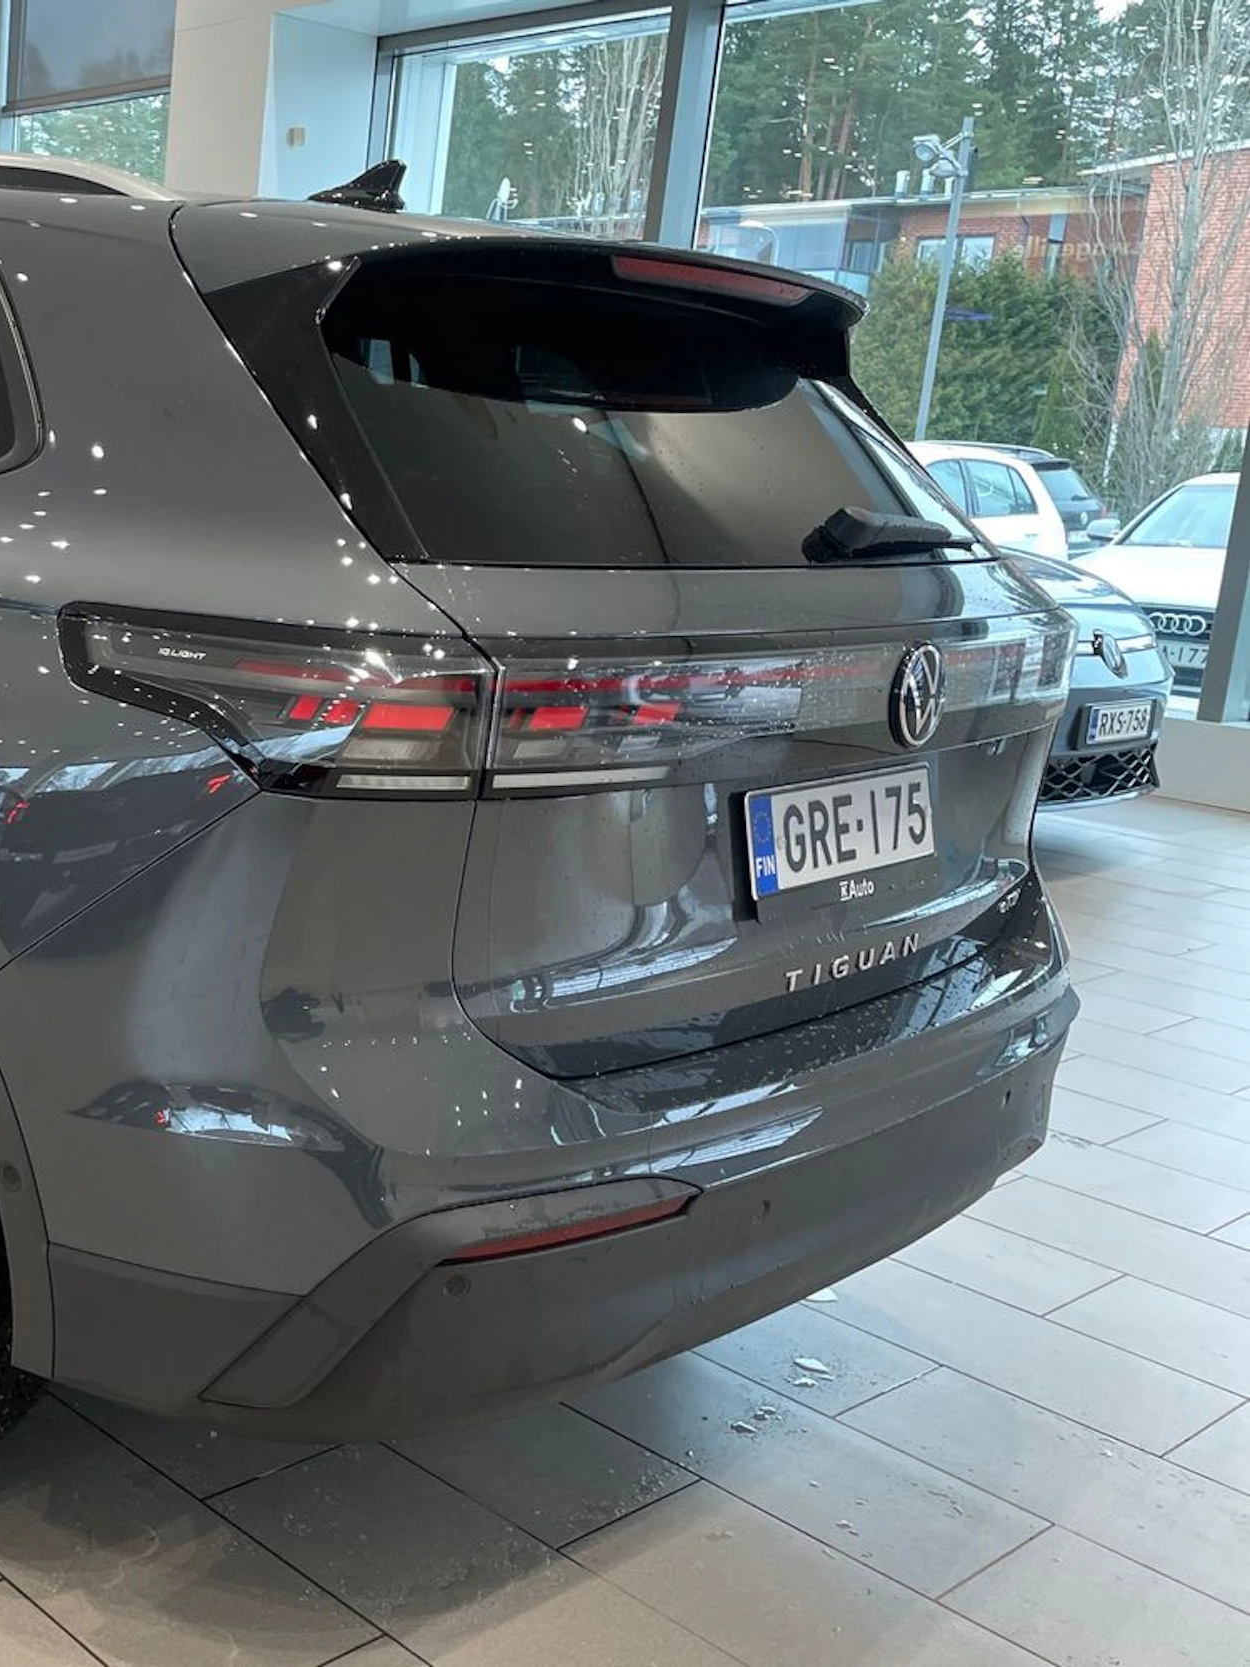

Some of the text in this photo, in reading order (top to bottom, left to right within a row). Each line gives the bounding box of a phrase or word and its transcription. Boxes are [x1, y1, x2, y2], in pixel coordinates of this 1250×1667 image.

[783, 782, 927, 873] GRE-175
[756, 854, 776, 878] FIN
[785, 932, 921, 993] TIGUAN
